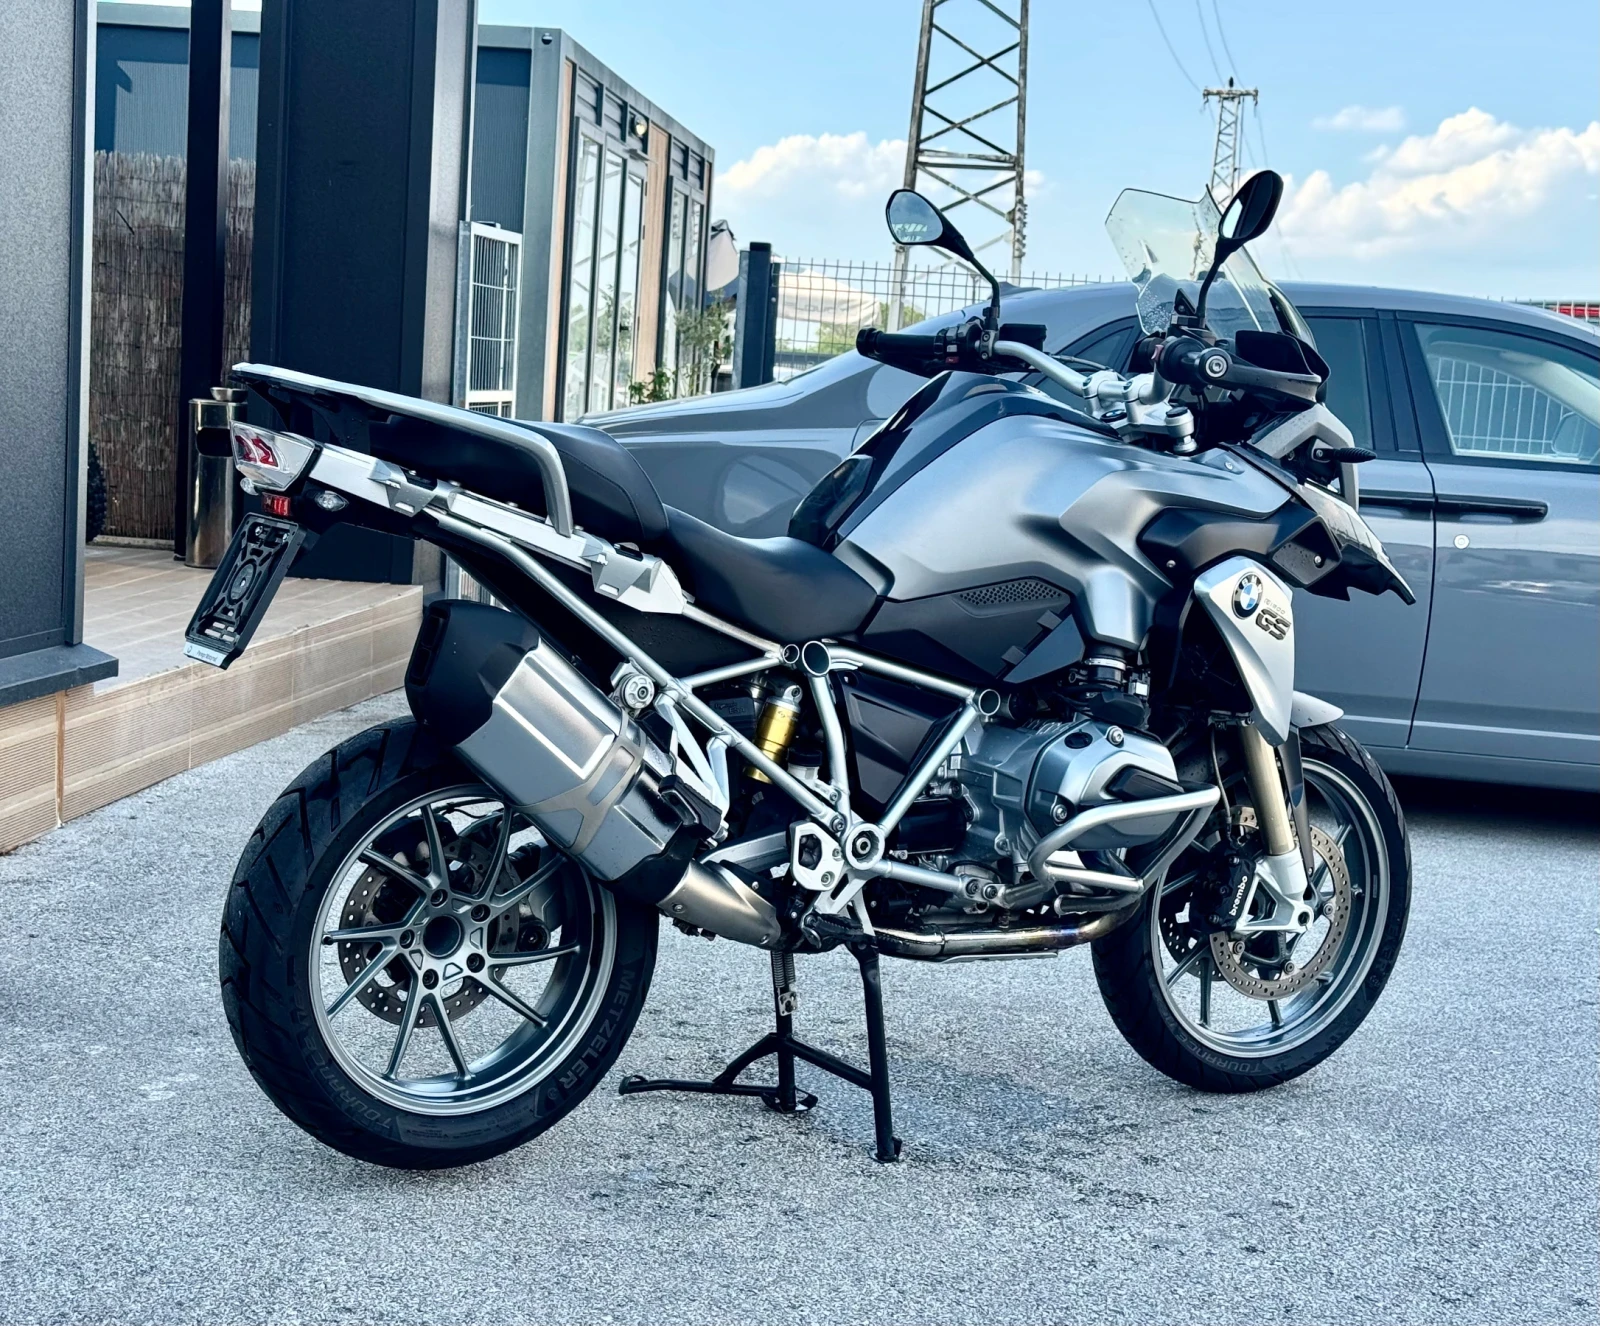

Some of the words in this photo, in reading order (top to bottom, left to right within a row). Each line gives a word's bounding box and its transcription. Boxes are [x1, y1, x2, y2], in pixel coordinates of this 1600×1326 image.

[1255, 608, 1292, 641] GS
[1229, 875, 1248, 917] brembo
[559, 969, 636, 1090] METZELER
[1175, 1031, 1263, 1074] TOURANCE
